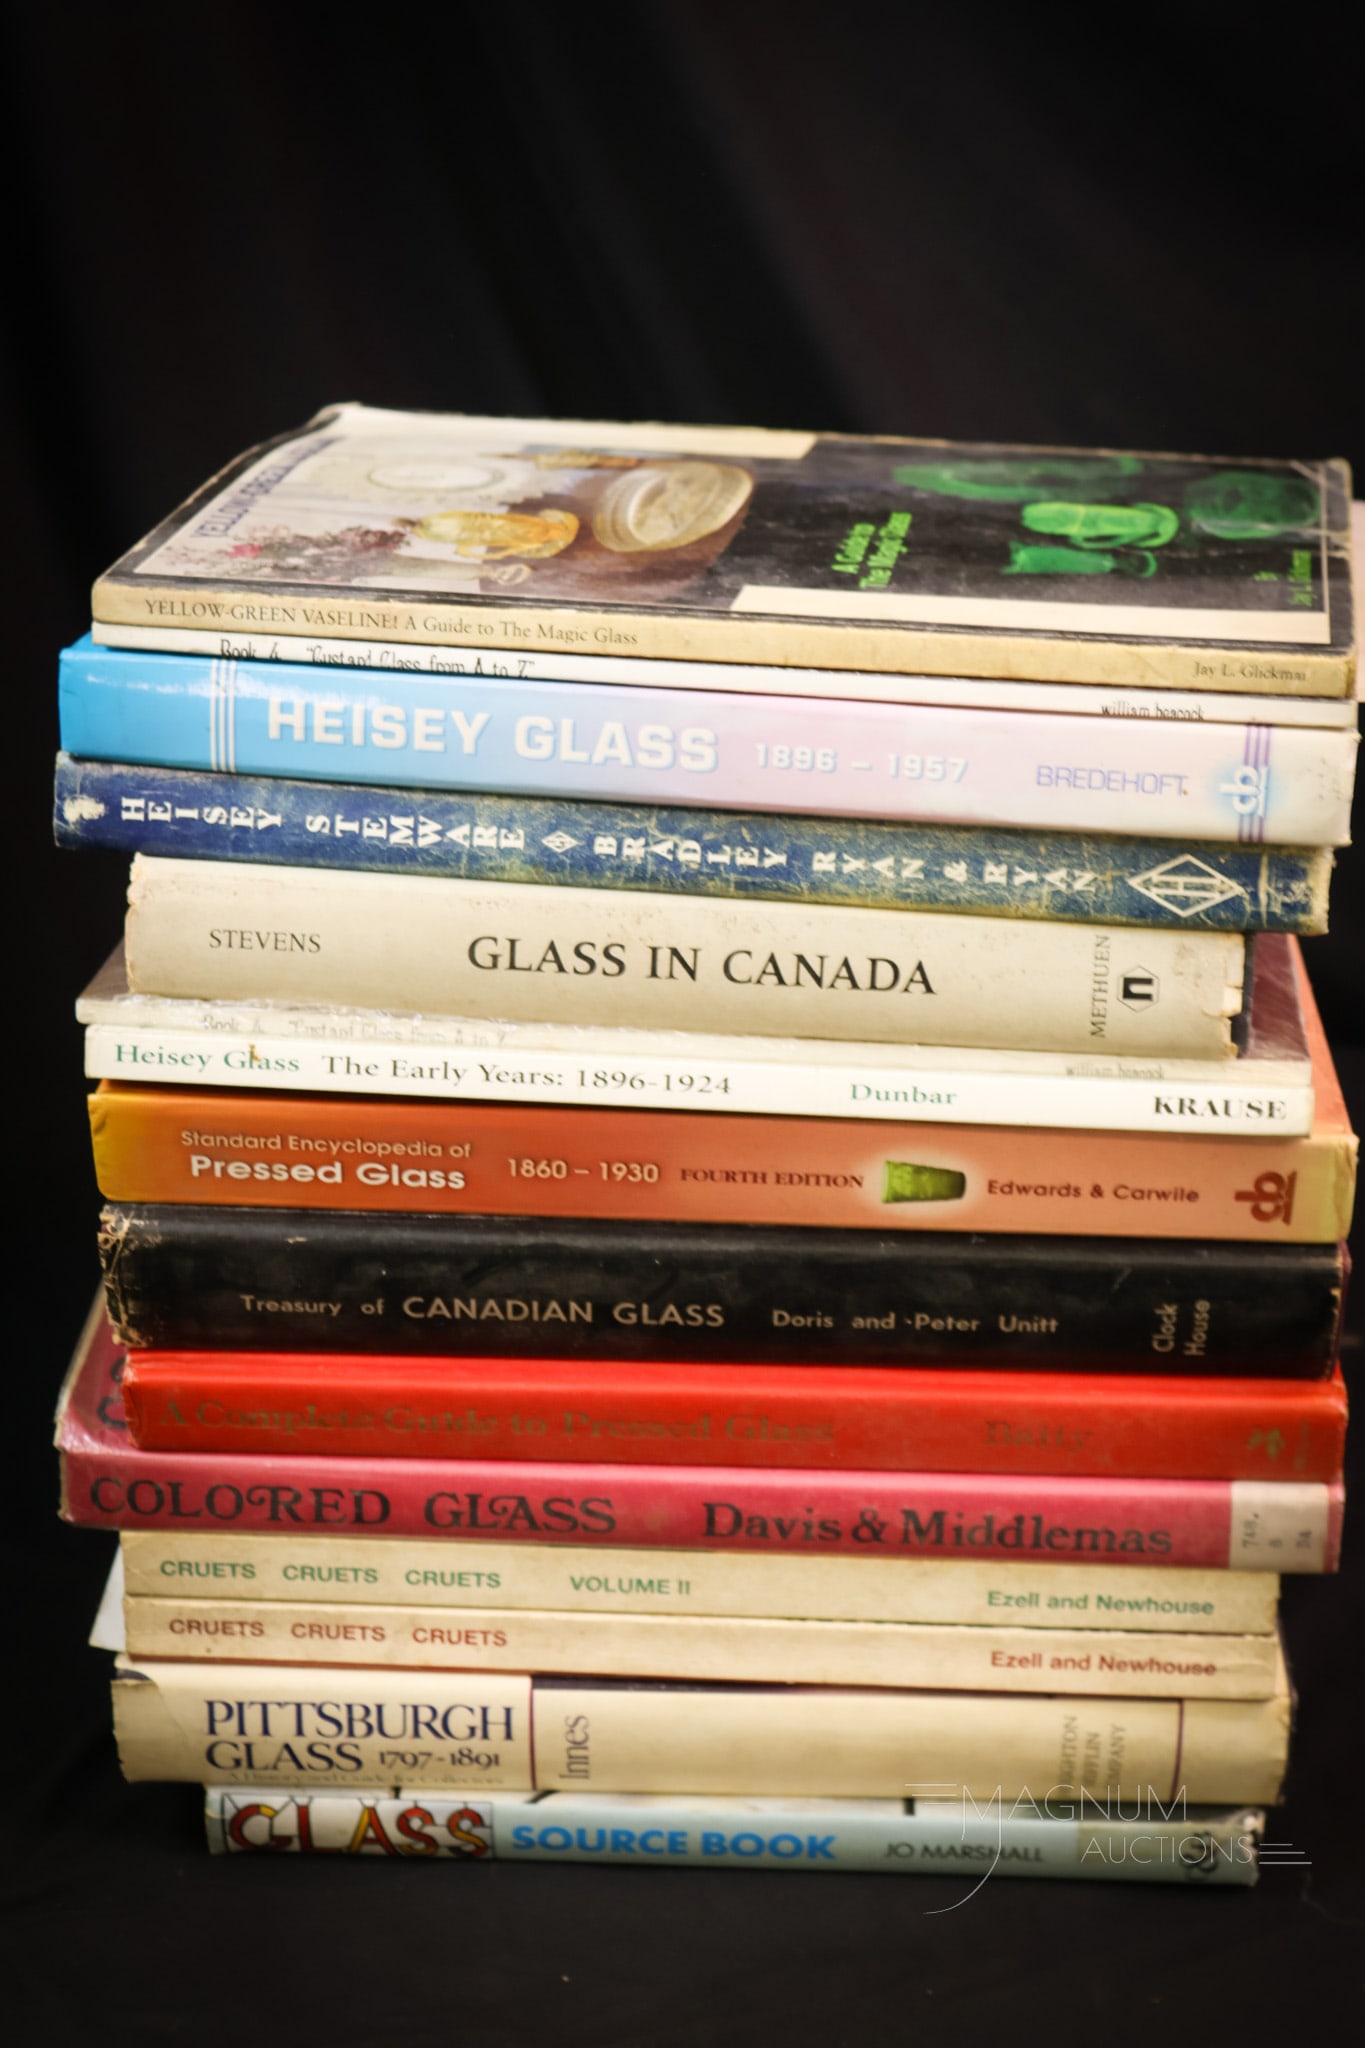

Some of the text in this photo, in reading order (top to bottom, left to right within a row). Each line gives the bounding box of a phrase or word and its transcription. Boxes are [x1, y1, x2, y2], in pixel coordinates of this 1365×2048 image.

[145, 600, 639, 645] YELLOW-GREEN VASELINE! A Guide to The Magic Glass
[1192, 661, 1216, 678] Jay
[268, 698, 490, 755] HEISEY
[514, 716, 719, 774] GLASS
[755, 742, 838, 774] 1896
[887, 752, 969, 784] 1957
[1035, 764, 1187, 797] BREDEHOFT
[121, 796, 283, 831] HEISEY
[305, 813, 526, 850] STEMWARE
[593, 835, 788, 868] BRADLEY
[812, 850, 925, 881] RYAN
[942, 859, 968, 884] &
[984, 860, 1099, 894] RYAN
[209, 929, 936, 996] STEVENS GLASS IN CANADA
[1090, 934, 1111, 1039] METHUEN
[115, 1043, 1287, 1120] Heisey Glass The Early Years: 1896-1924 Dunbar KRAUSE
[180, 1130, 472, 1159] Standard Encyclopedia of
[191, 1153, 466, 1189] Pressed Glass
[507, 1157, 567, 1179] 1860
[600, 1161, 659, 1184] 1930
[680, 1167, 769, 1186] FOURTH
[774, 1170, 864, 1190] EDITION
[987, 1179, 1083, 1200] Edwards
[1090, 1182, 1105, 1200] &
[1114, 1185, 1199, 1203] Carwile
[239, 1294, 1060, 1334] Treasury of CANADIAN GLASS Doris and Peter Unitt
[1152, 1303, 1179, 1353] Clock
[1184, 1299, 1211, 1357] House
[160, 1401, 188, 1426] A
[197, 1402, 375, 1435] Complete
[384, 1407, 499, 1434] Guide
[511, 1411, 548, 1436] to
[563, 1410, 712, 1441] Pressed
[724, 1413, 835, 1443] Glass
[90, 1478, 1173, 1556] COLORED GLASS Davis & Middlemas
[159, 1560, 1215, 1615] CRUETS CRUETS CRUETS VOLUME II Ezell and Newhouse
[169, 1618, 1217, 1677] CRUETS CRUETS CRUETS Ezell and Newhouse
[205, 1699, 515, 1742] PITTSBURGH
[559, 1714, 591, 1781] Innes
[205, 1739, 501, 1773] GLASS 1797-1891
[228, 1803, 1044, 1864] GLASS SOURCE BOOK JO MARSHALL
